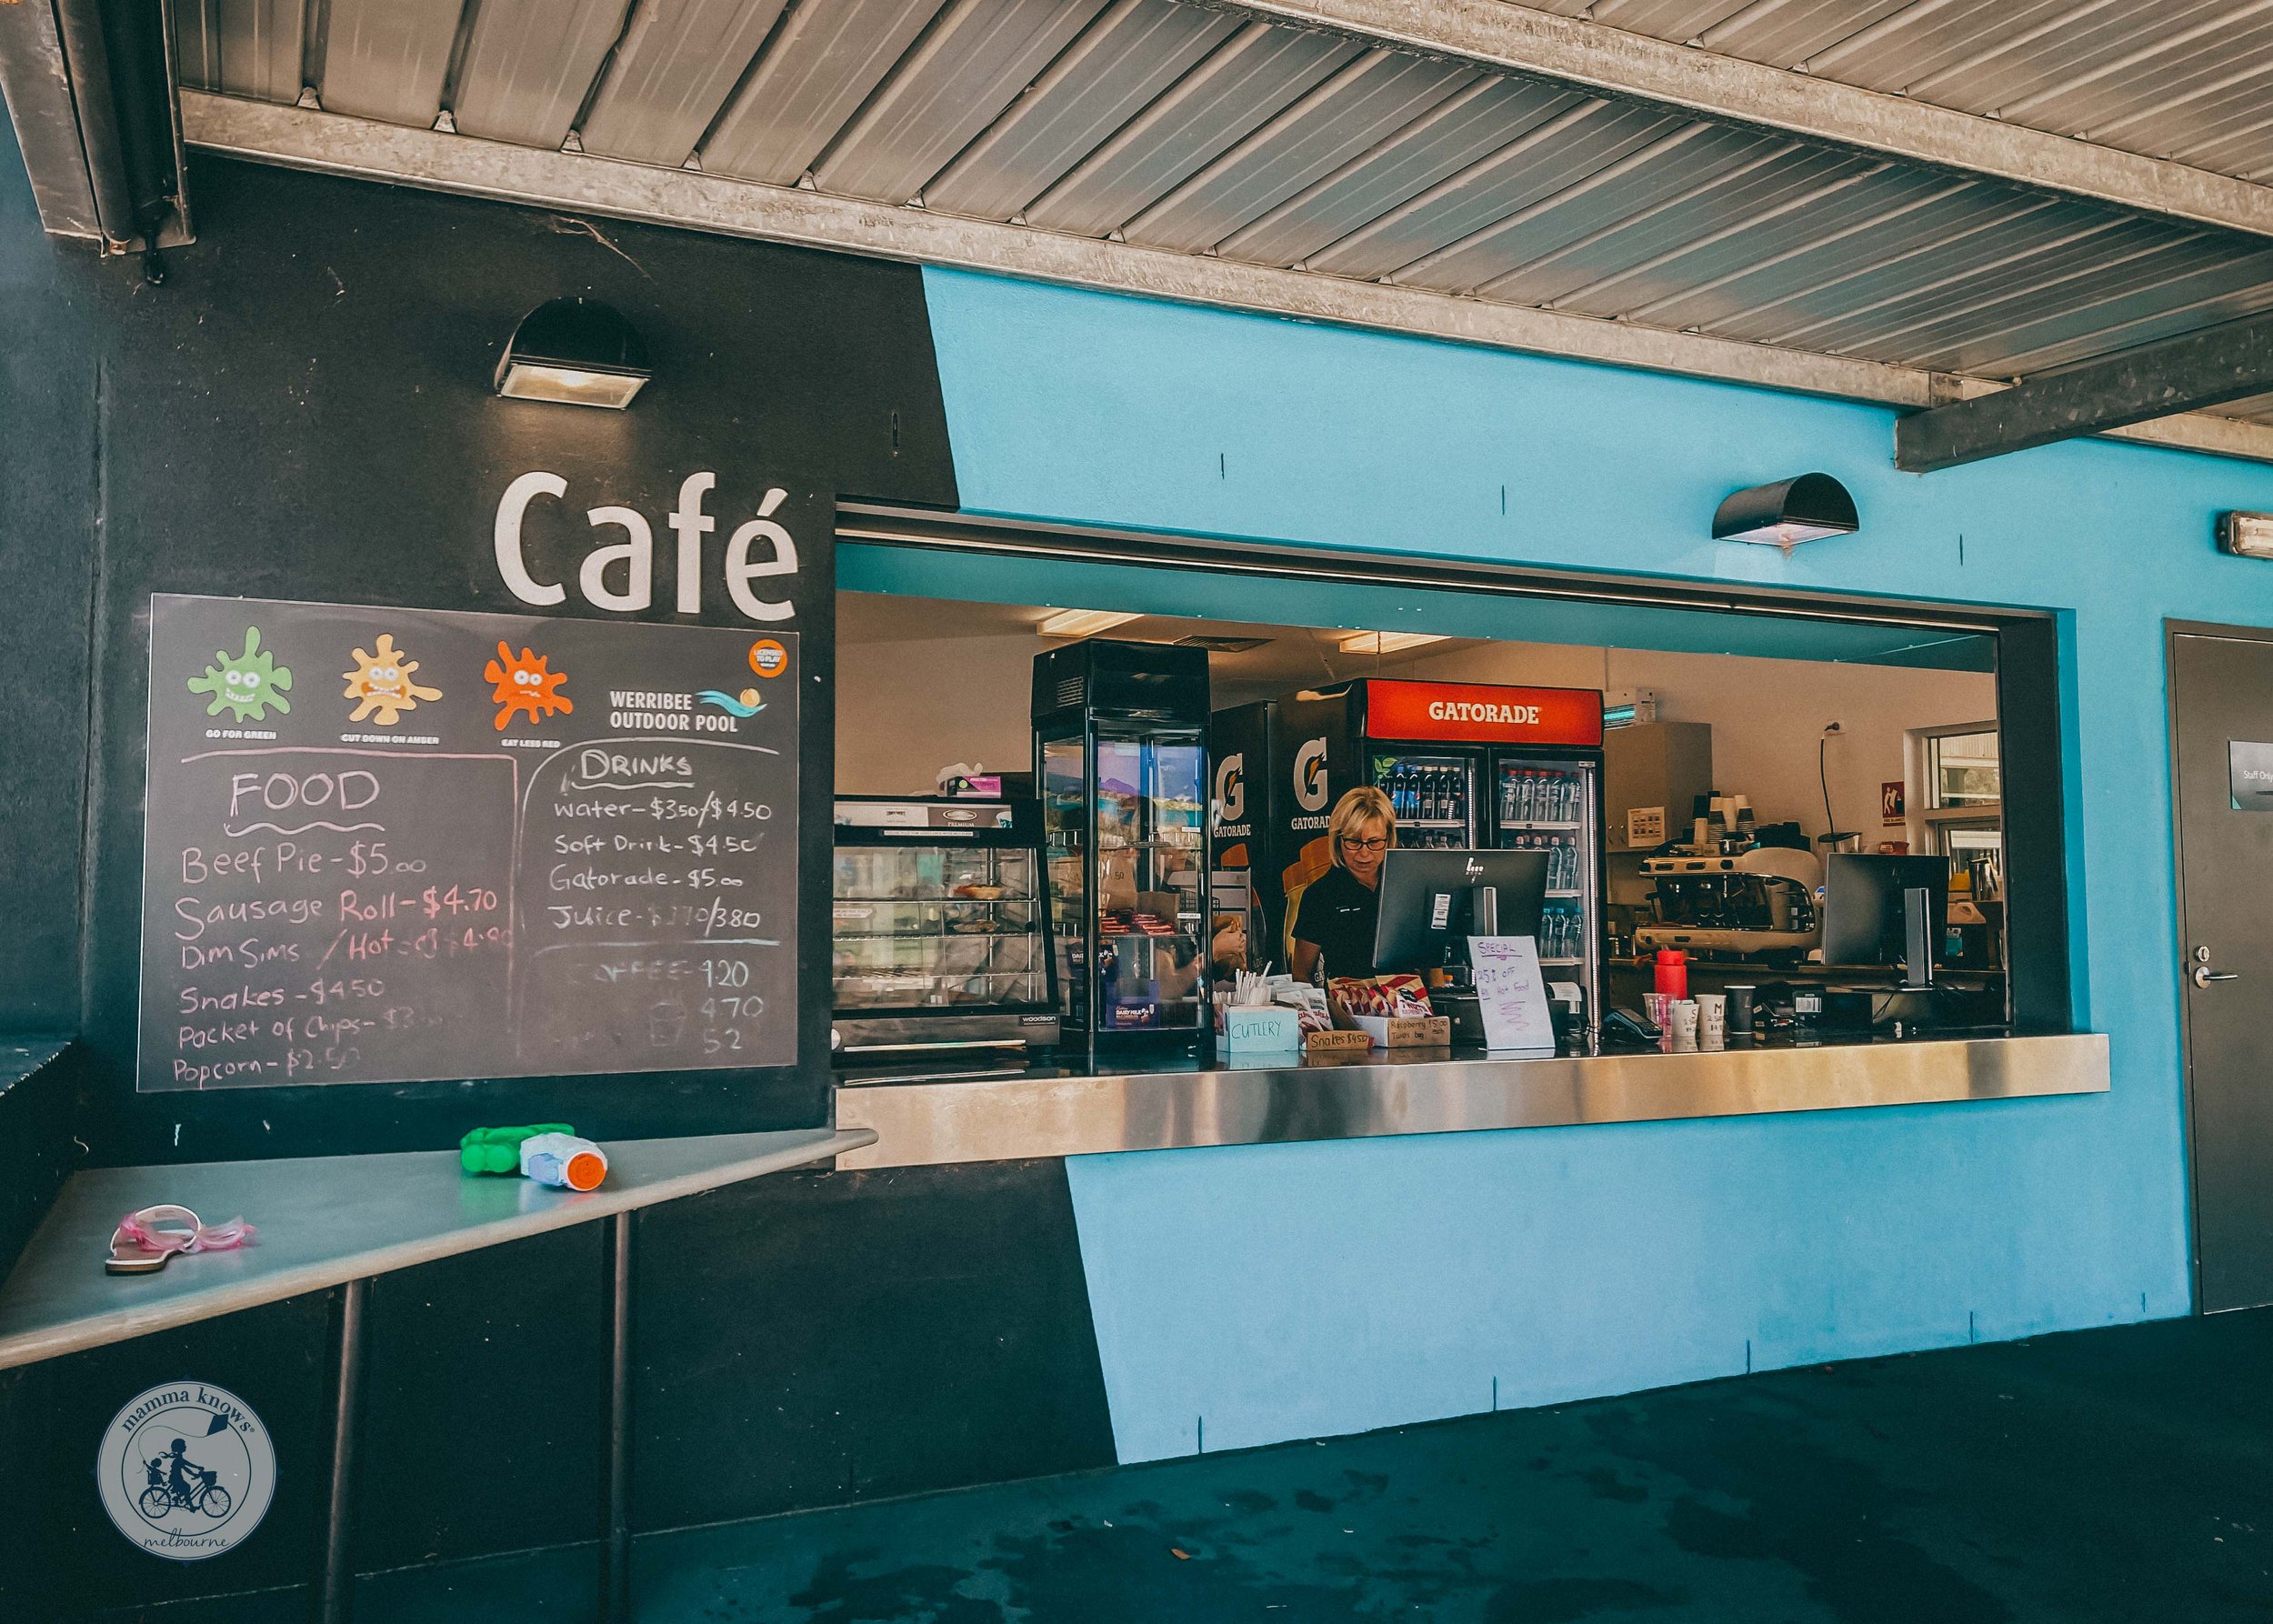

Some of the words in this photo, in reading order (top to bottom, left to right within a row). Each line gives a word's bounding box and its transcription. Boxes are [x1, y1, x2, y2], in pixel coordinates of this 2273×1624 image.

[494, 471, 800, 622] Café
[610, 691, 692, 710] WERRIBEE
[610, 712, 690, 731] OUTDOOR
[696, 715, 738, 733] POOL
[1428, 701, 1539, 725] GATORADE
[205, 729, 221, 738] GO
[222, 730, 243, 739] FOR
[243, 731, 276, 741] GREEN
[341, 734, 361, 742] CUT
[363, 735, 391, 744] DOWN
[391, 736, 406, 744] ON
[406, 736, 439, 745] AMBER
[501, 738, 518, 747] EAT
[519, 739, 541, 747] LESS
[2243, 770, 2259, 779] Staff
[2259, 771, 2273, 783] Only
[230, 770, 380, 817] FOOD
[1213, 824, 1251, 837] GATORADE
[1291, 815, 1332, 830] GATORAD
[555, 834, 606, 856] Soft
[182, 846, 266, 884] Beef
[175, 896, 324, 941] Sausage
[1713, 1003, 1723, 1016] M
[1231, 1020, 1282, 1039] CUTLERY
[1311, 1033, 1345, 1048] Snakes
